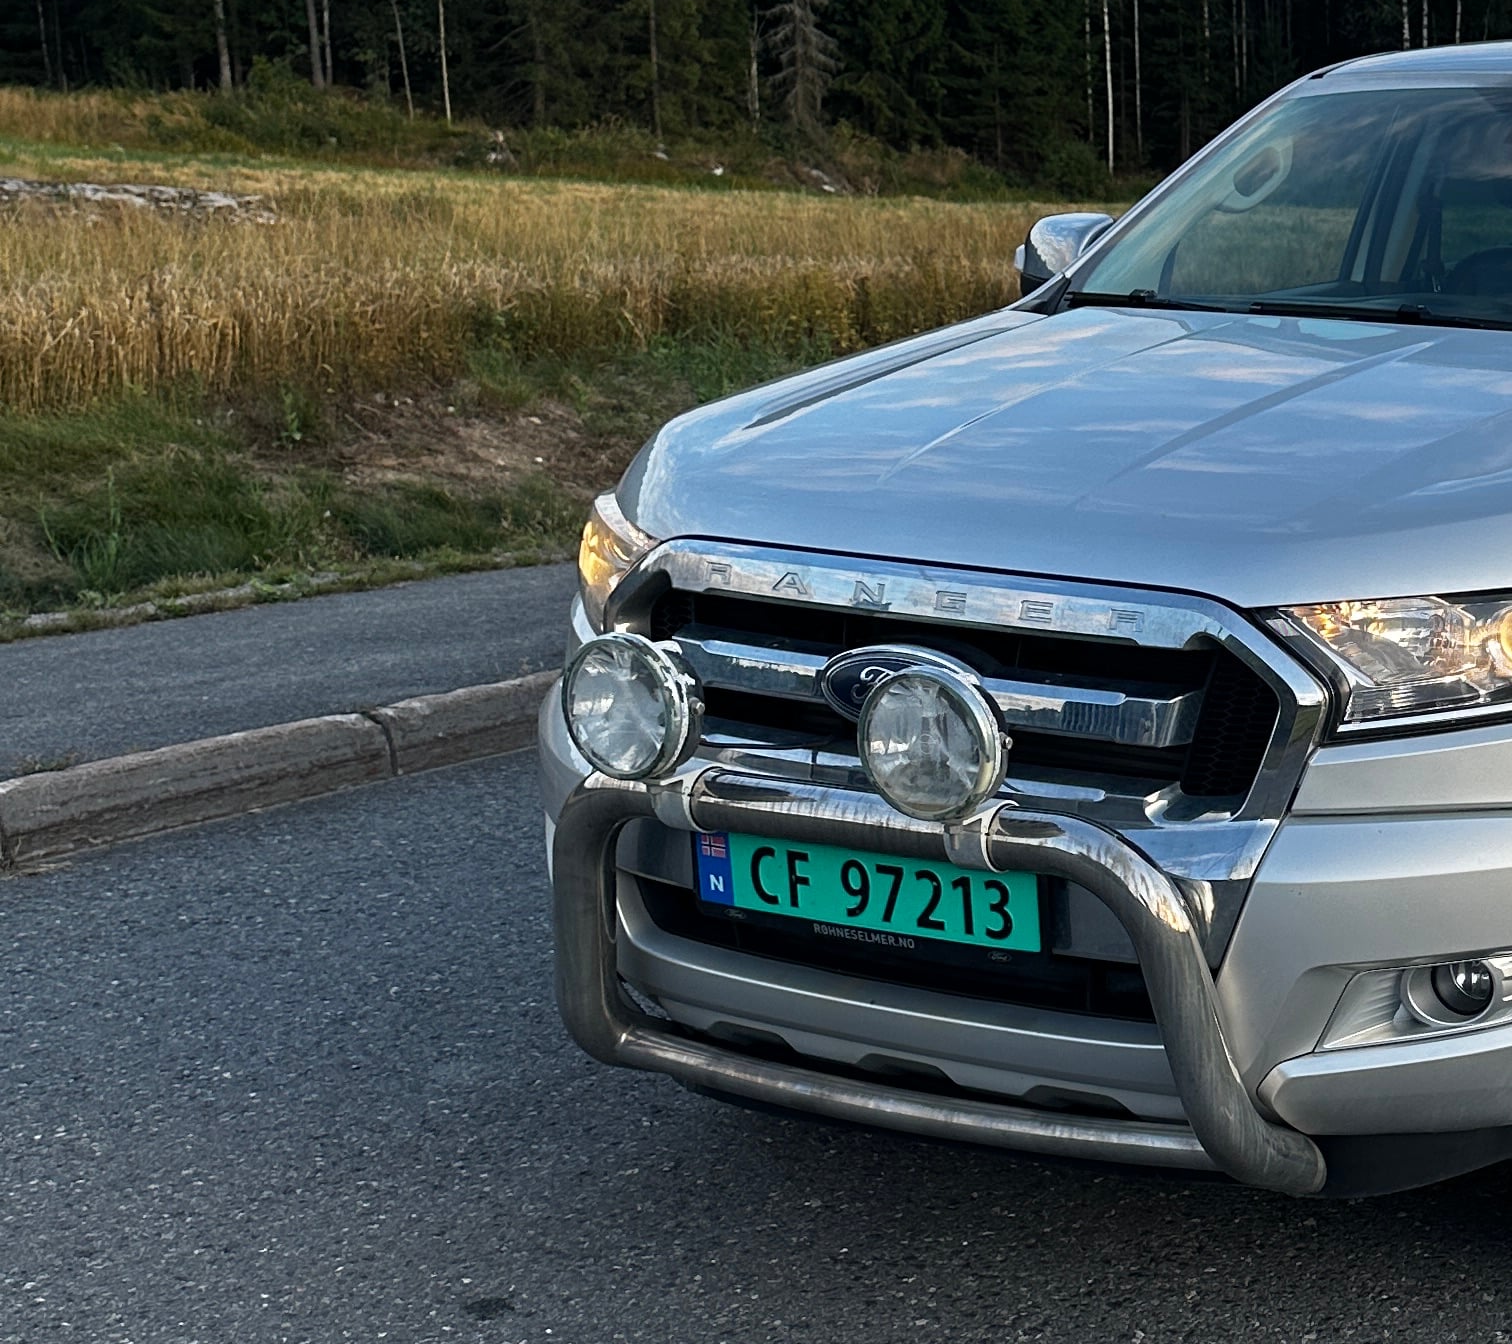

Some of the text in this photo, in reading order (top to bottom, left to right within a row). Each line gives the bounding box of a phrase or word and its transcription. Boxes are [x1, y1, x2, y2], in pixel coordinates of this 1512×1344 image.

[702, 560, 1144, 634] RANGER
[710, 874, 725, 893] N
[750, 846, 1014, 941] CF 97213
